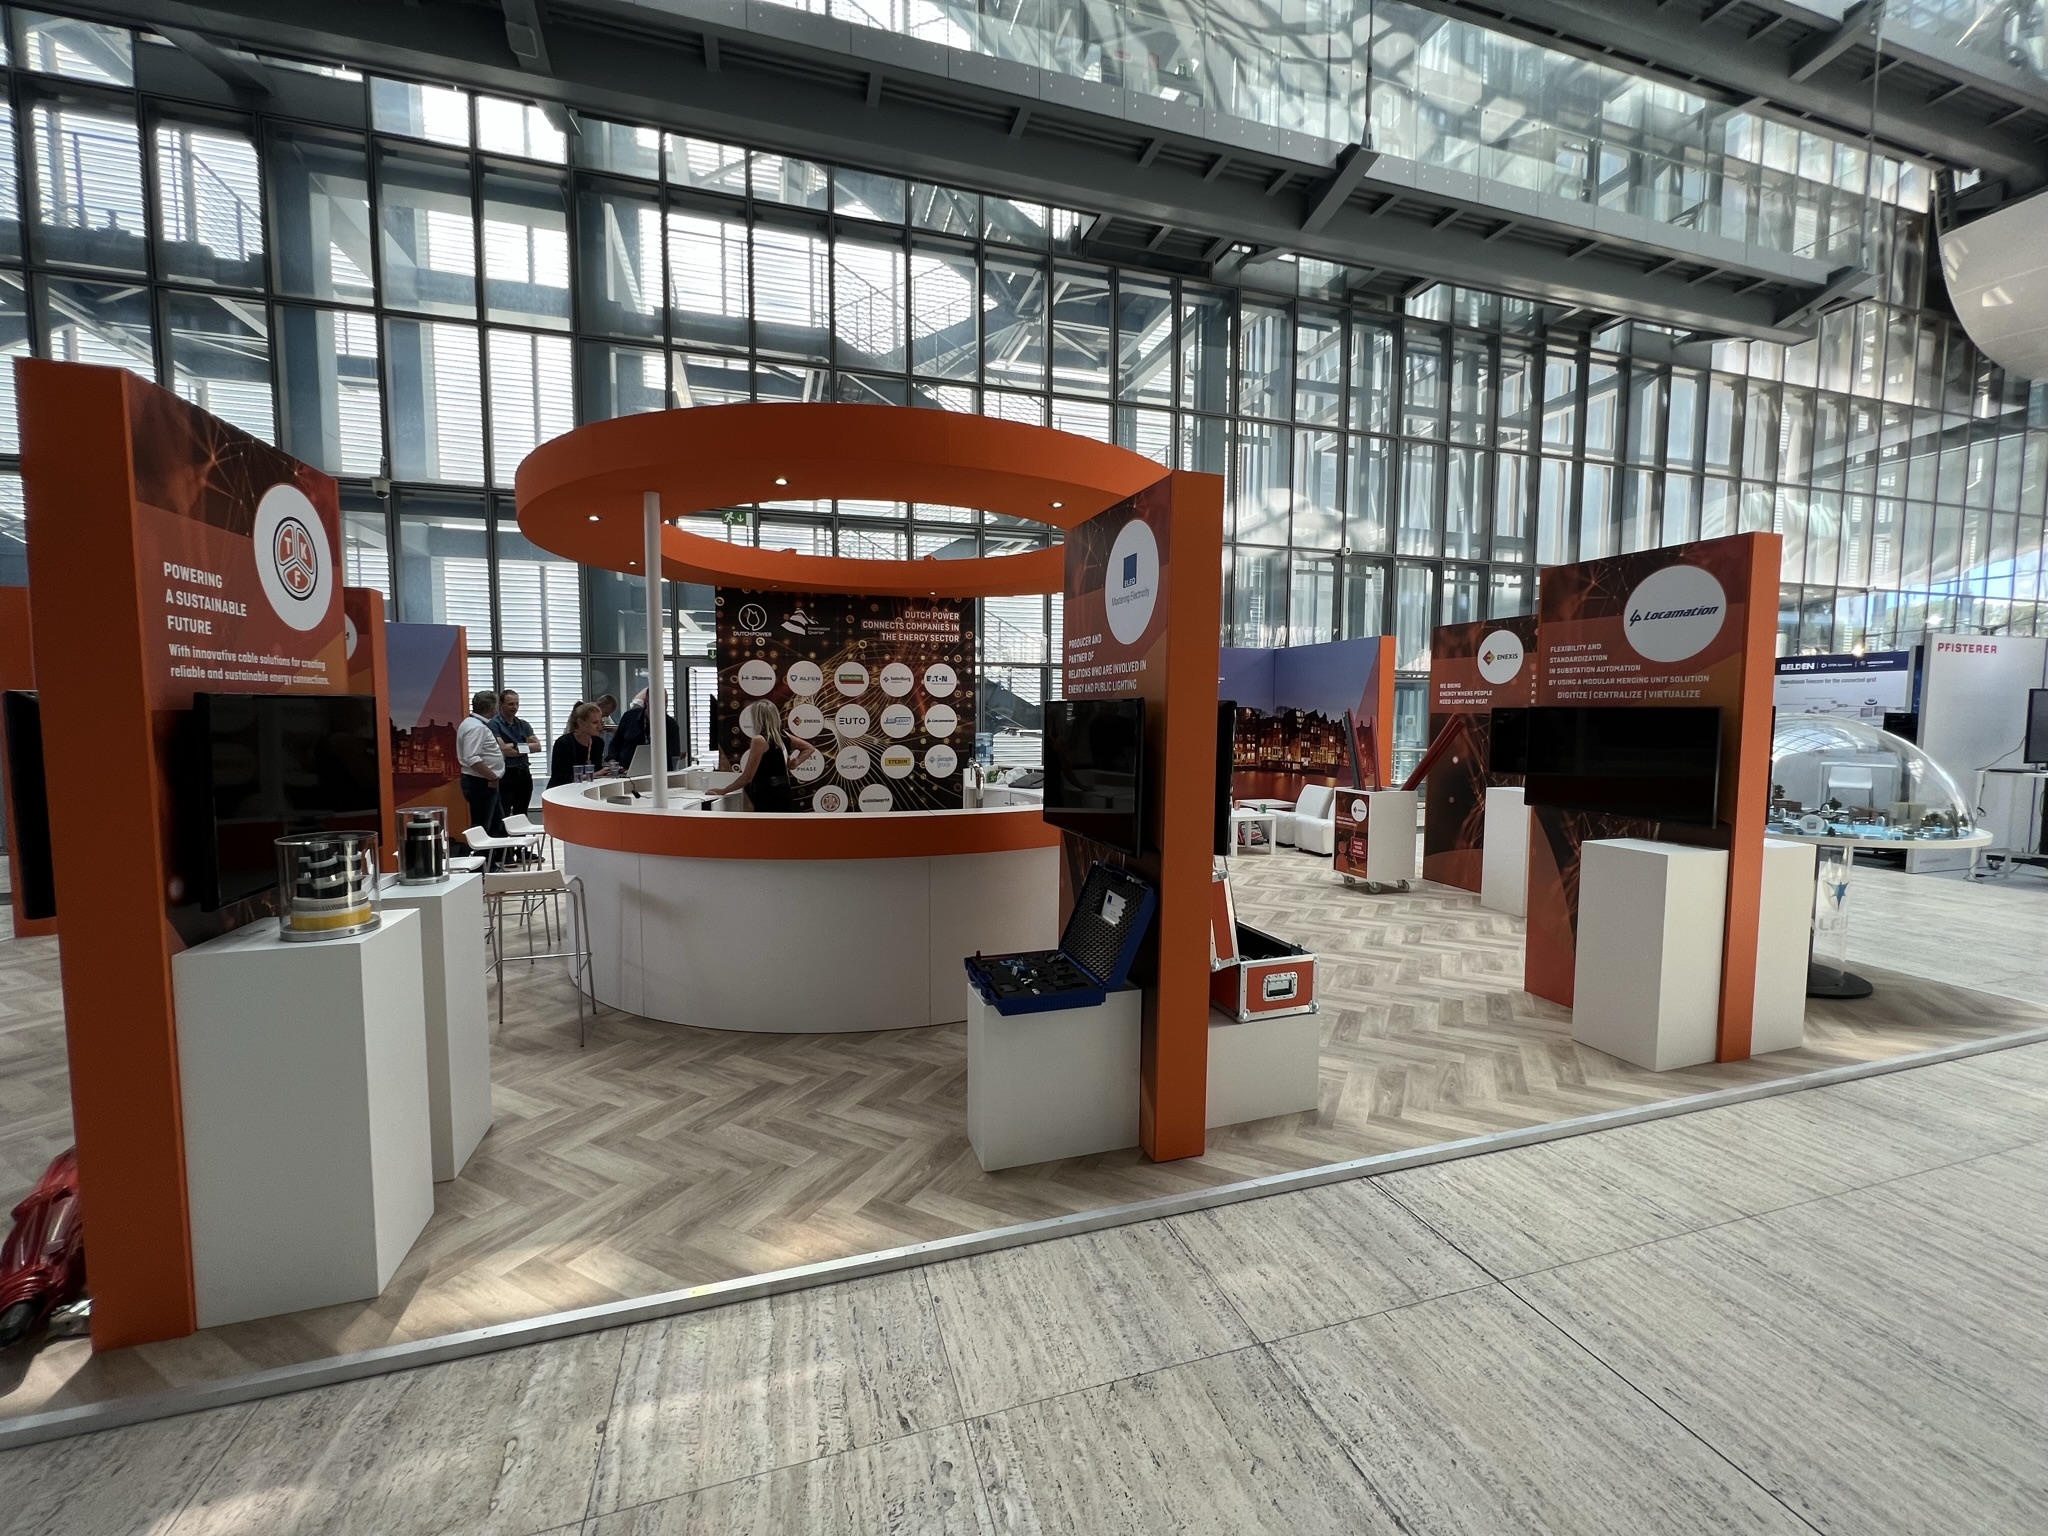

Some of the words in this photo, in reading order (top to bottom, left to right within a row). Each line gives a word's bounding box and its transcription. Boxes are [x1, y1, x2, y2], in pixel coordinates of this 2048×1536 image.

[164, 562, 222, 589] POWERING
[166, 589, 174, 604] A
[176, 591, 247, 617] SUSTAINABLE
[905, 611, 931, 619] DUTCH
[933, 612, 960, 620] POWER
[1644, 606, 1719, 620] Locamation
[168, 616, 212, 635] FUTURE
[863, 621, 904, 630] CONNECTS
[906, 623, 950, 631] COMPANIES
[882, 633, 896, 641] THE
[899, 633, 929, 641] ENERGY
[930, 634, 960, 643] SECTOR
[1069, 636, 1091, 649] PRODUCER
[1092, 634, 1102, 645] AND
[1550, 645, 1587, 653] FLEXIBILITY
[1938, 643, 1997, 654] PFISTERER
[169, 643, 191, 657] With
[193, 646, 237, 662] innovative
[238, 652, 258, 664] cable
[260, 654, 290, 667] solutions
[292, 657, 300, 668] for
[302, 659, 325, 671] creating
[1069, 653, 1087, 664] PARTNER
[1088, 651, 1094, 661] OF
[1550, 655, 1608, 663] STANDARDIZATION
[1069, 668, 1091, 679] RELATIONS
[1092, 666, 1102, 677] WHO
[1102, 665, 1112, 676] ARE
[1113, 661, 1139, 674] INVOLVED
[1140, 660, 1146, 671] IN
[1557, 666, 1595, 674] SUBSTATION
[1781, 662, 1815, 671] BELDEN
[170, 666, 206, 679] reliable
[208, 668, 224, 680] and
[225, 670, 268, 682] sustainable
[270, 673, 292, 685] energy
[1558, 678, 1576, 686] USING
[1651, 676, 1668, 684] UNIT
[1670, 675, 1710, 683] SOLUTION
[1068, 683, 1084, 694] ENERGY
[1084, 682, 1094, 693] AND
[1095, 681, 1112, 692] PUBLIC
[1112, 679, 1137, 691] LIGHTING
[1558, 691, 1588, 699] DIGITIZE
[1594, 690, 1642, 698] CENTRALIZE
[1649, 690, 1700, 698] VIRTUALIZE
